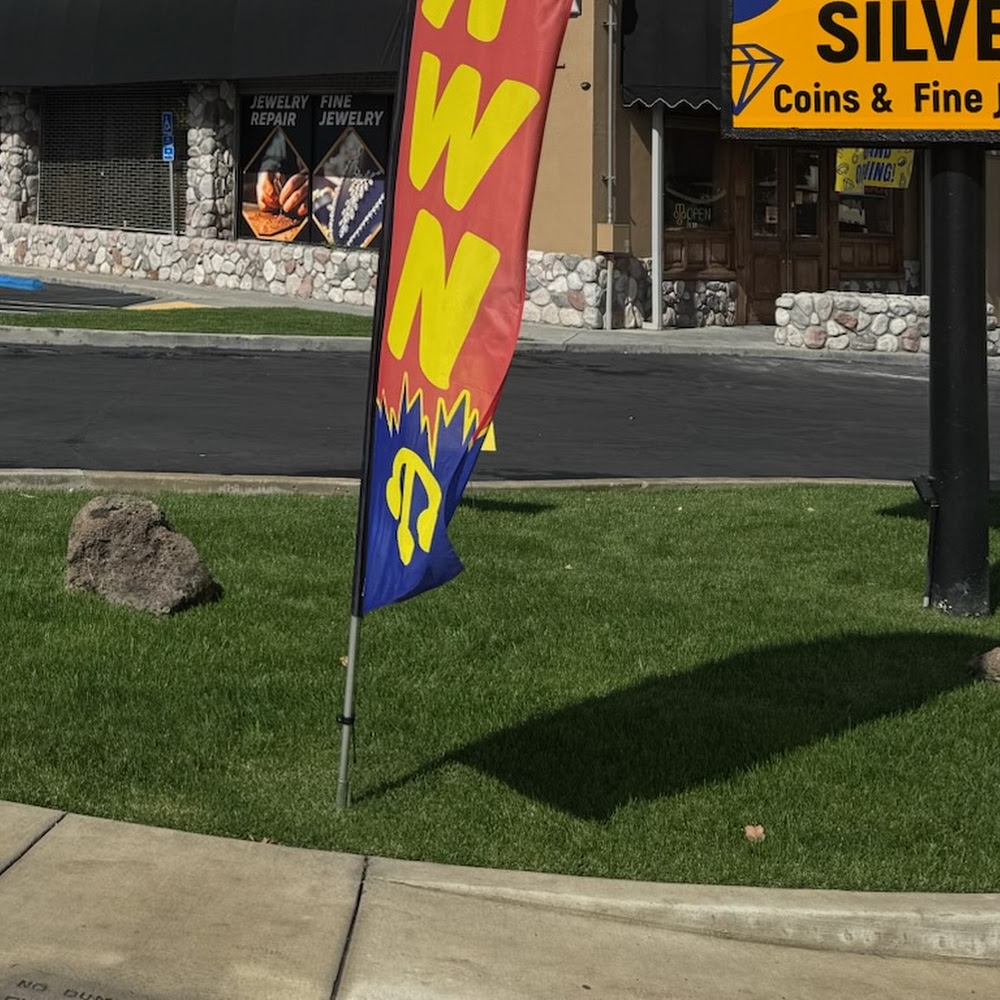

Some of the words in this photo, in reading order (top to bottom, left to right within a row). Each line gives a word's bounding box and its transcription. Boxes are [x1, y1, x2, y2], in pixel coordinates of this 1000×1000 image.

[250, 95, 309, 109] JEWELRY
[319, 94, 353, 108] FINE
[773, 82, 859, 113] Coins
[872, 83, 893, 113] &
[914, 81, 982, 113] Fine
[250, 111, 297, 126] REPAIR
[318, 111, 384, 126] JEWELRY
[17, 979, 48, 992] NO
